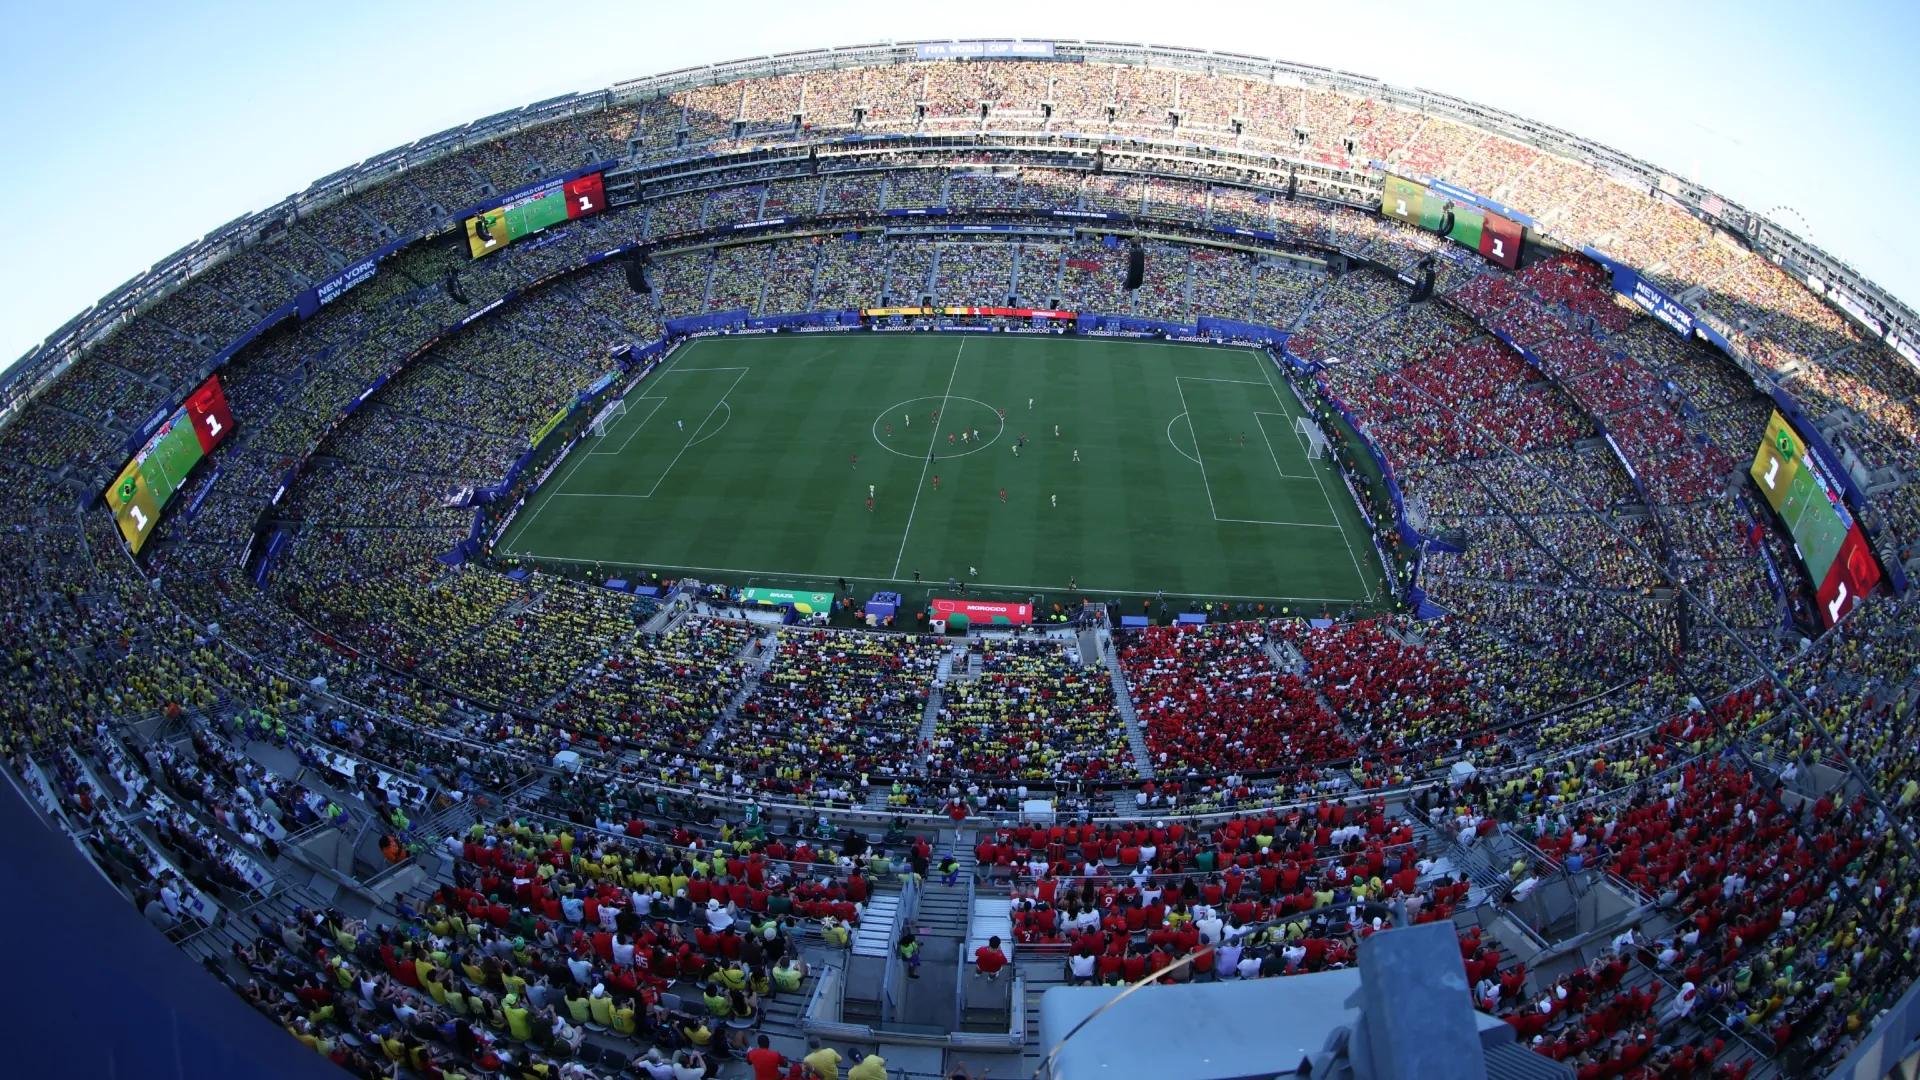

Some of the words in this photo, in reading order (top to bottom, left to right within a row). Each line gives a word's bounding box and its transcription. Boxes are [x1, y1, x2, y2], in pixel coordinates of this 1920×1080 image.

[948, 45, 983, 53] WORLD
[502, 195, 514, 204] FIFA
[514, 188, 533, 199] WORLD
[579, 196, 592, 210] 1
[1395, 200, 1408, 216] 1
[1492, 239, 1505, 258] 1
[318, 277, 344, 296] NEW
[344, 260, 375, 282] YORK
[320, 290, 342, 305] NEW
[342, 268, 377, 292] JERSEY
[1637, 282, 1661, 304] NEW
[1663, 299, 1692, 326] YORK
[1634, 292, 1655, 311] NEW
[1655, 308, 1689, 336] JERSEY
[1232, 340, 1262, 349] motorola
[206, 414, 222, 436] 1
[1764, 456, 1779, 490] 1
[130, 506, 148, 531] 1
[1828, 582, 1848, 623] 1
[1105, 897, 1113, 907] 9
[1025, 932, 1031, 942] 2
[635, 955, 648, 969] 85
